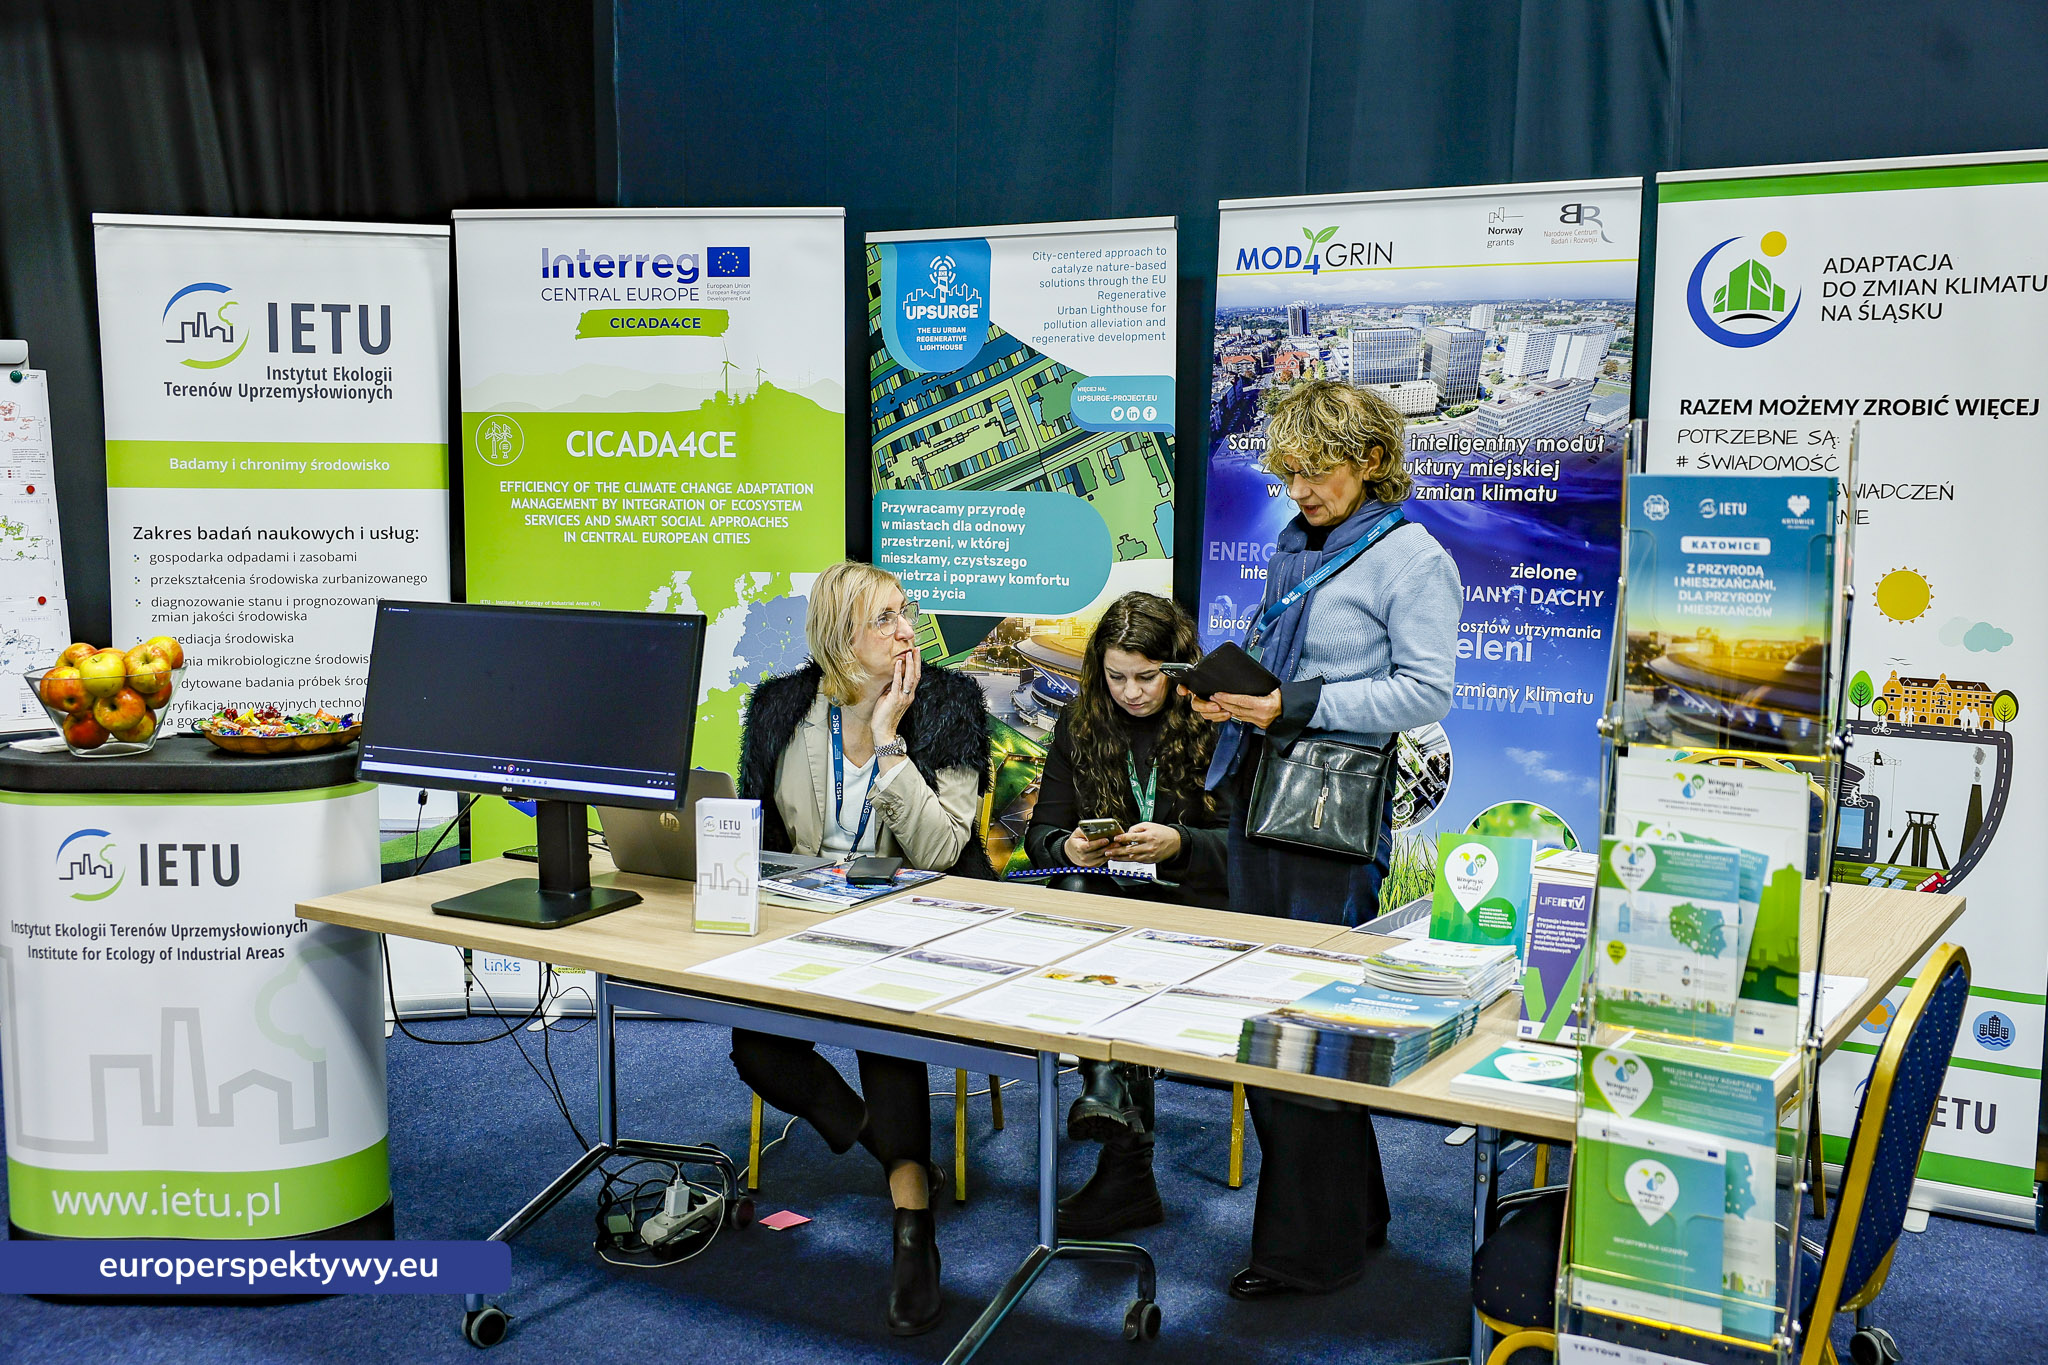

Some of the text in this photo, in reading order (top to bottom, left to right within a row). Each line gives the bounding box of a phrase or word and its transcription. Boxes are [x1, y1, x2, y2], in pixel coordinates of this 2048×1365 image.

[1488, 227, 1523, 236] Norway
[1487, 239, 1515, 249] grants
[1573, 237, 1598, 245] Rozwoju
[1032, 247, 1154, 262] City-centered approach
[541, 247, 700, 284] Interreg
[1051, 260, 1167, 276] catalyze nature-based
[1822, 253, 1954, 275] ADAPTACJA
[706, 283, 734, 291] European
[1039, 274, 1167, 289] solutions through the EU
[1822, 274, 2048, 298] DO ZMIAN KLIMATU
[541, 287, 700, 302] CENTRAL EUROPE
[1097, 289, 1167, 302] Regenerative
[905, 303, 979, 320] UPSURGE
[1057, 302, 1167, 317] Urban Lighthouse for
[1821, 299, 1943, 324] NA ŚLĄSKU
[266, 302, 392, 355] IETU
[609, 317, 701, 329] CICADA4CE
[943, 326, 966, 334] URBAN
[1043, 317, 1167, 331] pollution alleviation and
[916, 335, 967, 343] REGENERATIVE
[1031, 331, 1167, 346] regenerative development
[266, 365, 393, 386] Instytut Ekologii
[163, 381, 393, 403] Terenów Uprzemysłowionych
[1077, 394, 1158, 402] UPSURGE-PROJECT.EU
[1679, 394, 2041, 420] RAZEM MOŻEMY ZROBIĆ WIĘCEJ
[565, 430, 737, 459] CICADA4CE
[1411, 433, 1605, 456] inteligentny moduł
[1677, 428, 1841, 449] POTRZEBNE SĄ:
[169, 457, 390, 474] Badamy chronimy środowisko
[1469, 457, 1561, 479] miejskiej
[1696, 452, 1840, 472] ŚWIADOMOŚĆ
[499, 481, 814, 496] EFFICIENCY THE CLIMATE CHANGE ADAPTATION
[1415, 483, 1558, 503] zmian klimatu
[510, 498, 803, 512] MANAGEMENT INTEGRATION ECOSYSTEM
[881, 501, 1026, 518] Przywracamy przyrodę
[1719, 502, 1747, 516] IETU
[524, 514, 789, 529] SERVICES AND SMART SOCIAL APPROACHES
[891, 518, 1026, 536] miastach dla odnowy
[133, 525, 419, 544] Zakres badań naukowych usług:
[563, 531, 751, 545] IN CENTRAL EUROPEAN CITIES
[881, 535, 1010, 552] przestrzeni, której
[1691, 540, 1761, 551] KATOWICE
[149, 552, 358, 566] gospodarka odpadami zasobami
[881, 553, 1027, 569] mieszkamy, czystszego
[1510, 563, 1578, 581] zielone
[1698, 564, 1764, 579] PRZYRODĄ
[150, 573, 428, 588] przekształcenia środowiska zurbanizowanego
[950, 572, 1070, 588] poprawy komfortu
[1681, 576, 1776, 592] MIESZKAŃCAMI,
[932, 586, 966, 601] życia
[1530, 588, 1605, 607] DACHY
[1678, 590, 1772, 604] DLA PRZYRODY
[151, 596, 283, 610] diagnozowanie stanu
[1683, 603, 1772, 618] MIESZKAŃCÓW
[151, 610, 308, 625] zmian jakości środowiska
[225, 632, 294, 645] środowiska
[1515, 622, 1601, 640] utrzymania
[207, 654, 311, 668] mikrobiologiczne
[245, 676, 295, 689] badania
[298, 676, 341, 690] próbek
[1455, 683, 1595, 705] zmiany klimatu
[719, 820, 741, 831] IETU
[140, 843, 241, 887] IETU
[11, 919, 308, 941] Instytut Ekologii Terenów Uprzemysłowionych
[28, 945, 285, 964] Institute for Ecology of Industrial Areas
[484, 957, 521, 972] links
[1931, 1096, 1997, 1135] ETU
[51, 1181, 281, 1226] www.ietu.pl
